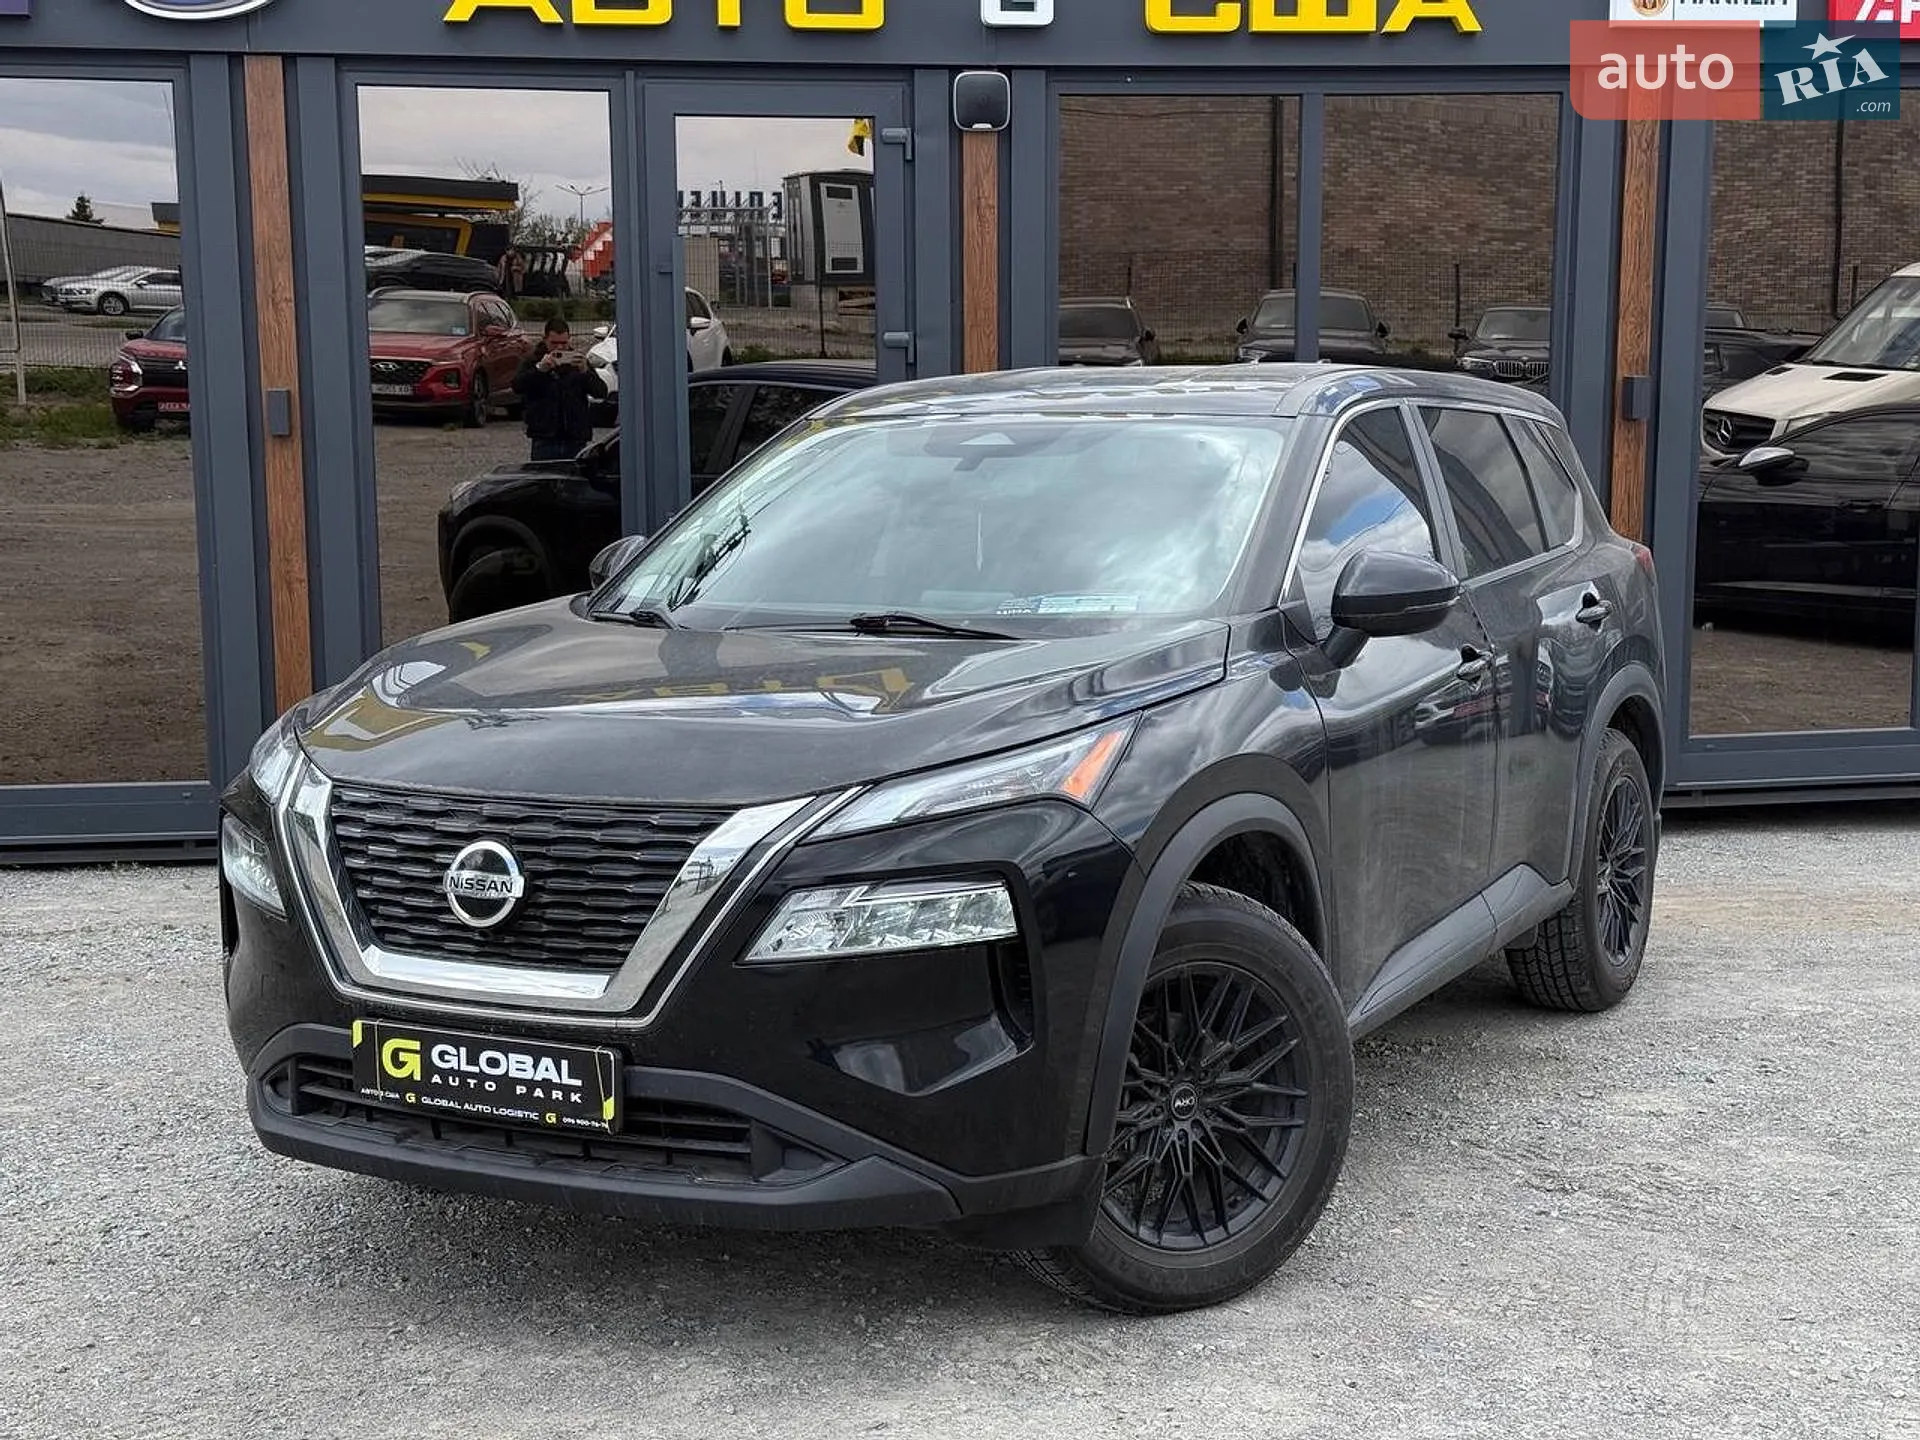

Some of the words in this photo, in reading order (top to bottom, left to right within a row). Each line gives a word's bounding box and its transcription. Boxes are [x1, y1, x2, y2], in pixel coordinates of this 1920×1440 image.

[450, 876, 513, 893] NISSAN
[431, 1044, 582, 1086] GLOBAL
[431, 1074, 496, 1091] AUTO
[516, 1085, 582, 1103] PARK
[421, 1096, 462, 1109] GLOBAL
[463, 1102, 492, 1113] AUTO
[493, 1106, 539, 1120] LOGISTIC
